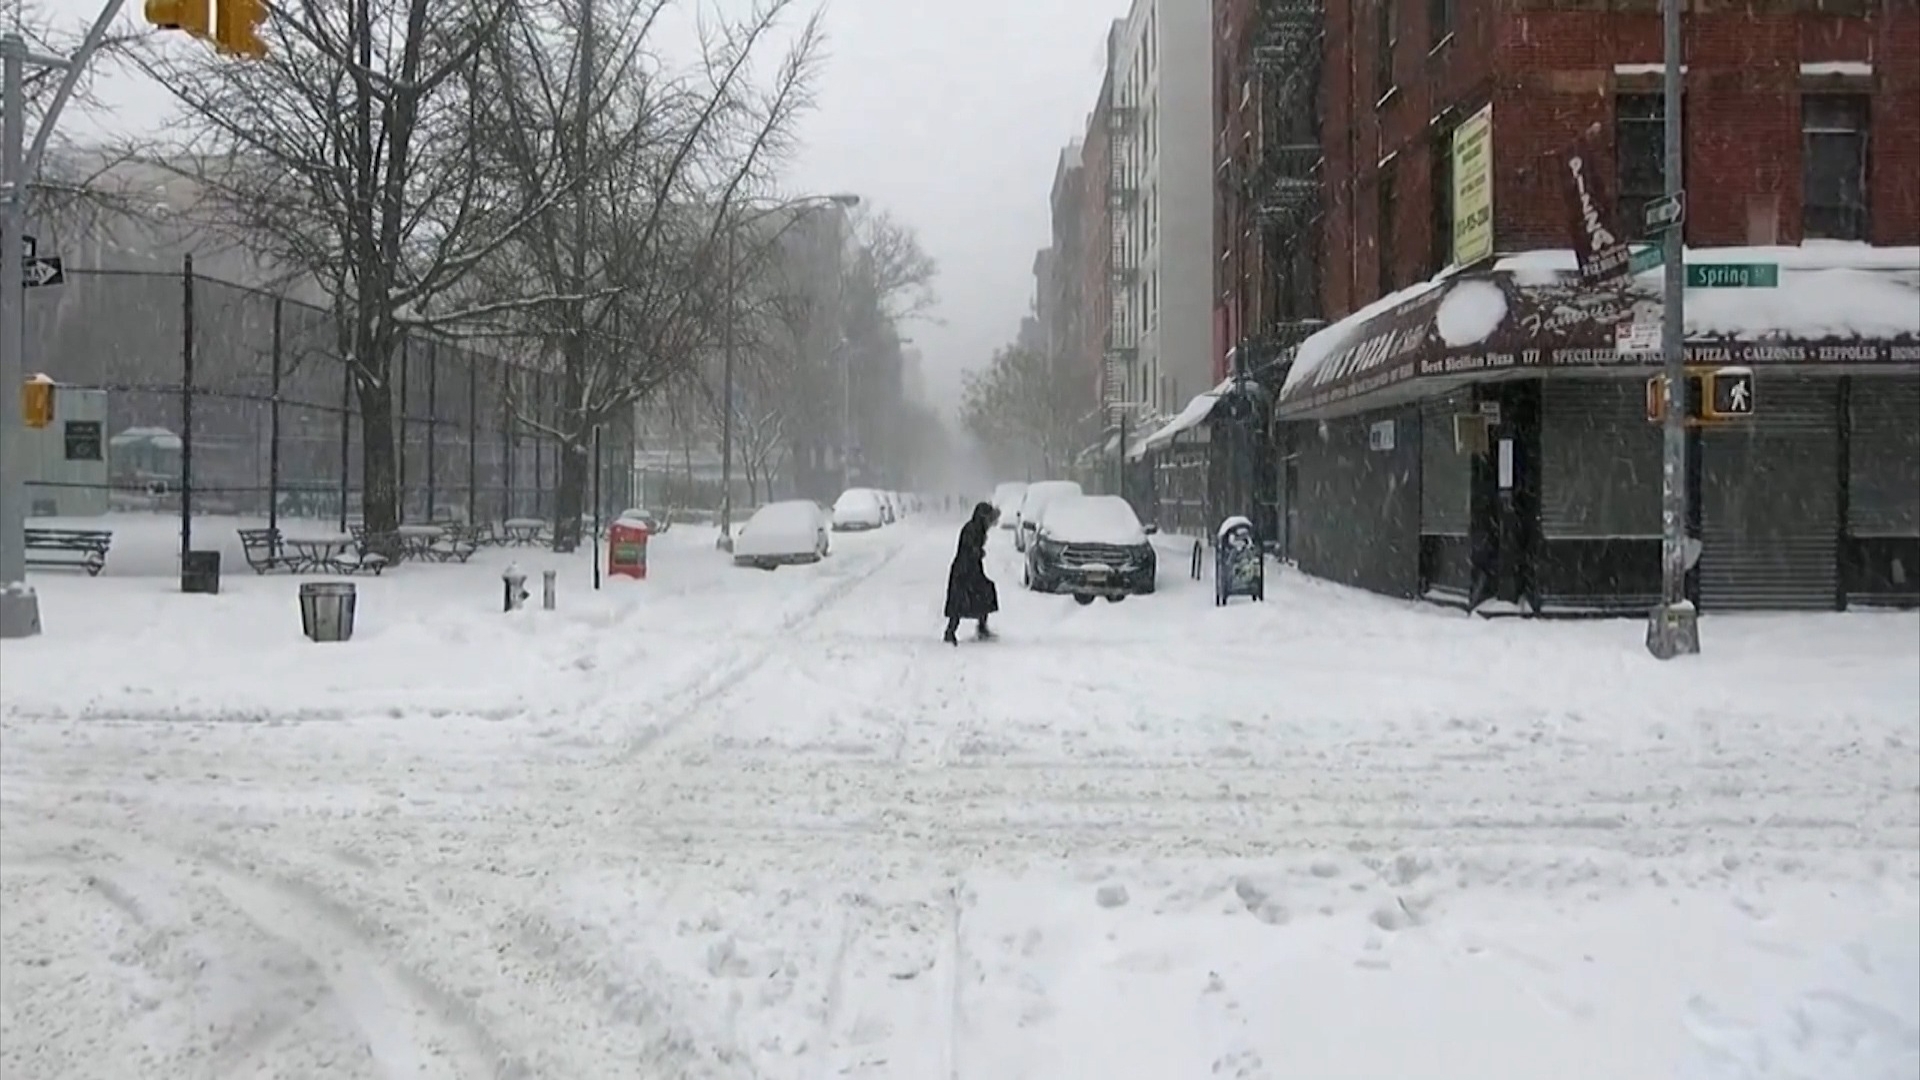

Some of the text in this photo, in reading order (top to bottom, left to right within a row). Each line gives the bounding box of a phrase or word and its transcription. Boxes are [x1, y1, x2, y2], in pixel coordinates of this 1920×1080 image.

[1568, 156, 1615, 251] PIZZA
[1698, 266, 1748, 288] Spring
[1421, 349, 1541, 373] Best Sicilian Pizza 177
[1696, 347, 1731, 361] PIZZA
[1743, 346, 1806, 361] CALZONES
[1819, 346, 1878, 361] ZEPPOLES
